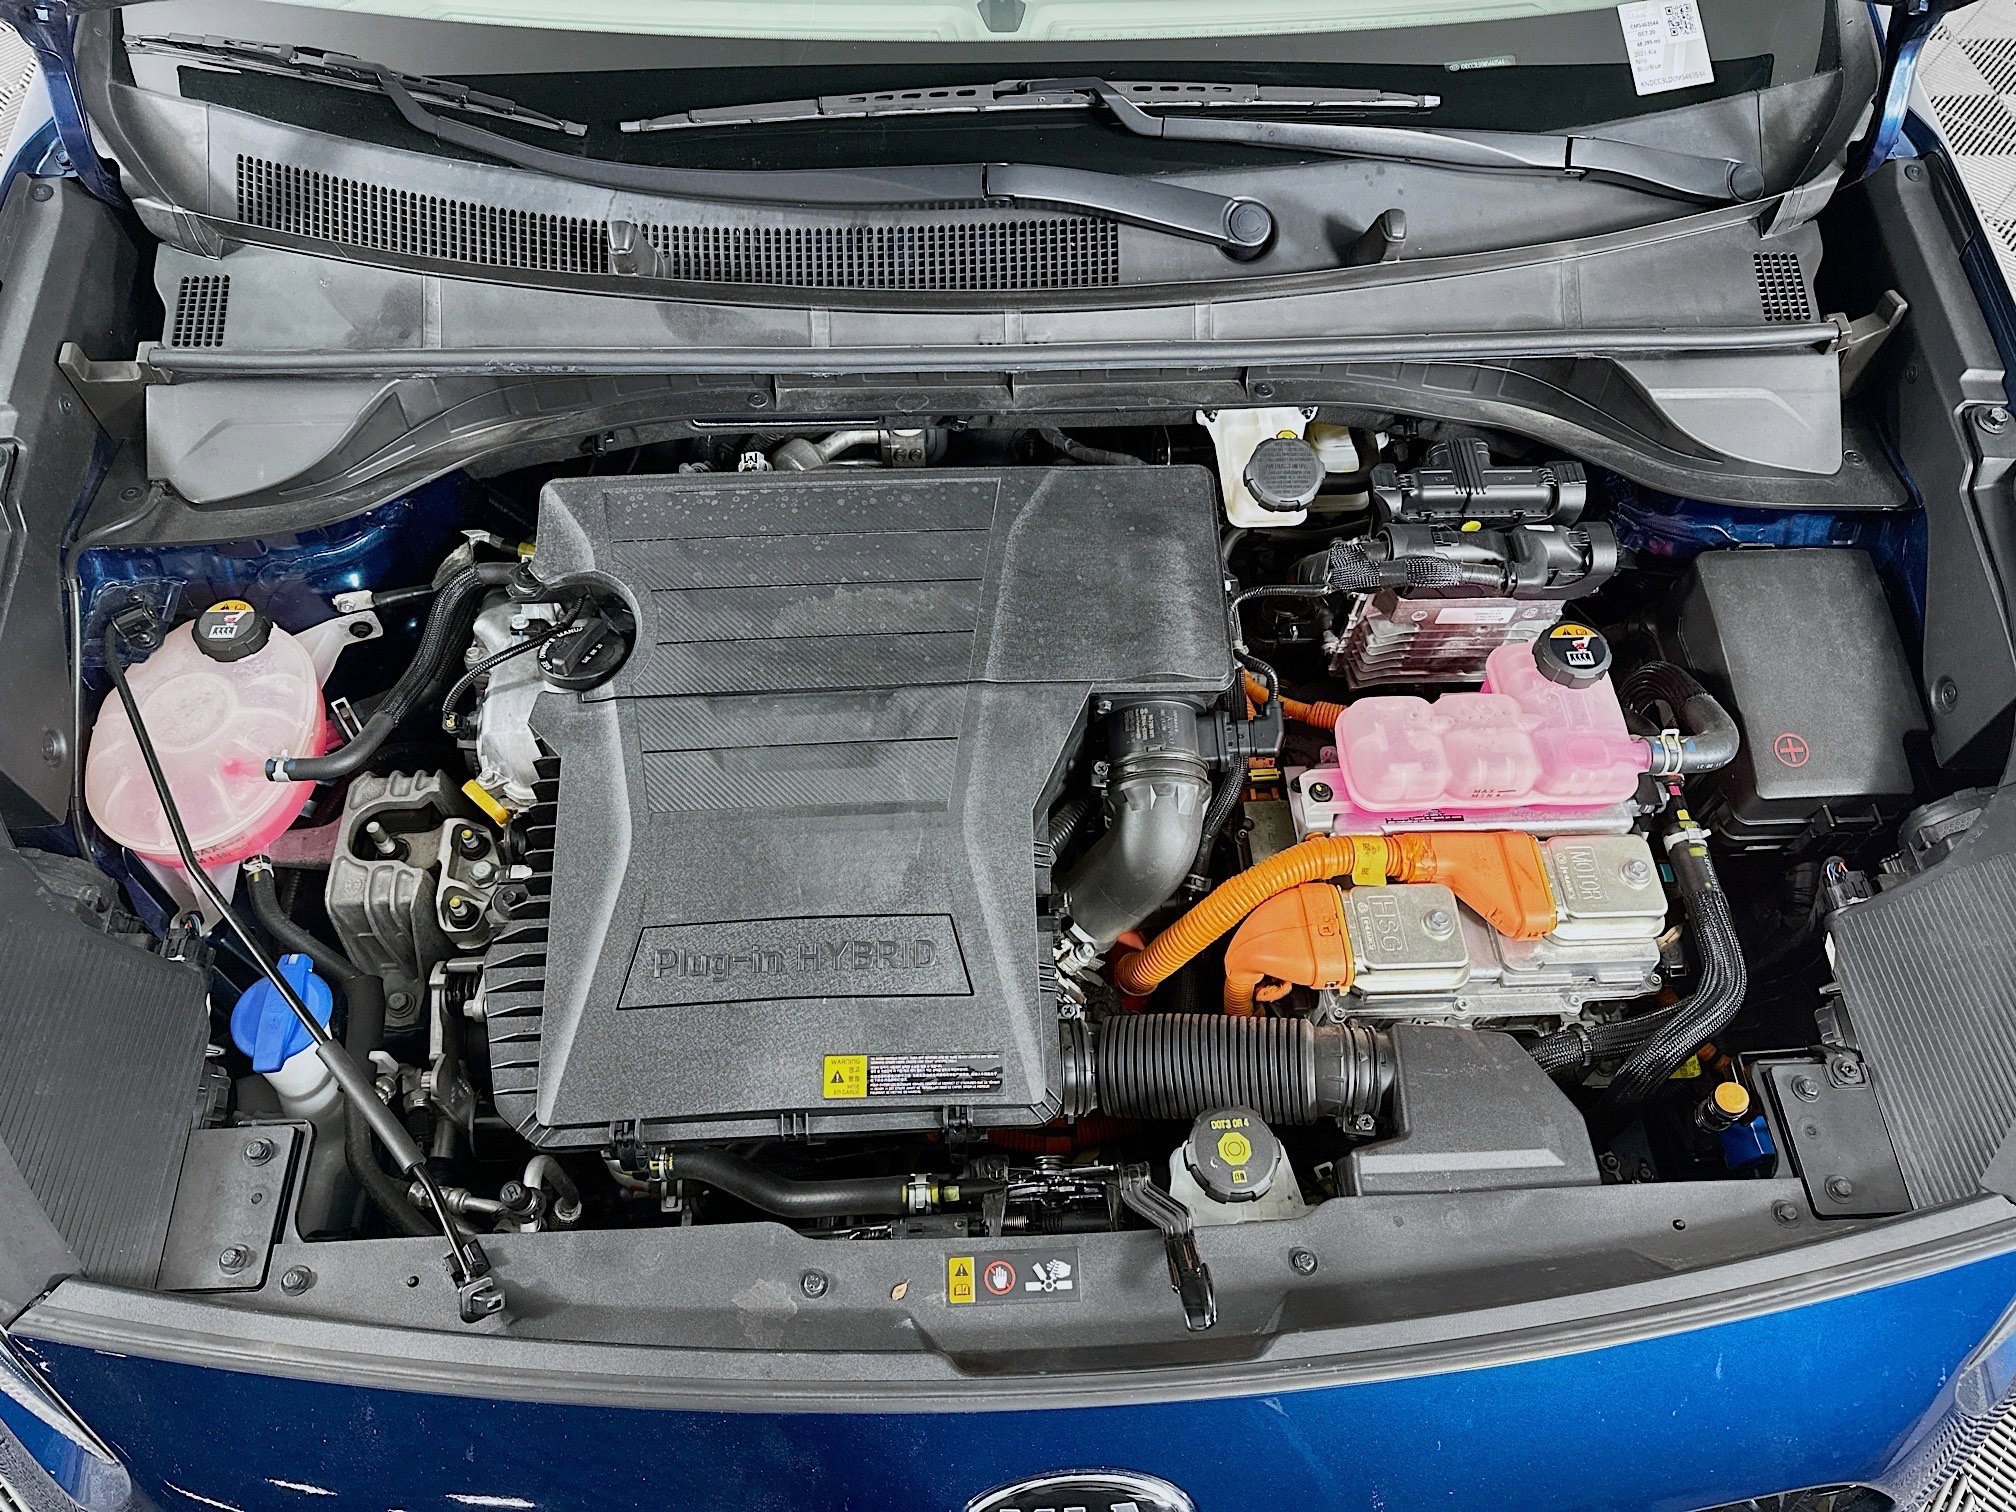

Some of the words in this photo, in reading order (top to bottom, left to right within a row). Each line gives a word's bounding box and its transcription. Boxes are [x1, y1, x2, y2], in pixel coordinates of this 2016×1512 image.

[1569, 850, 1603, 900] MOTOR
[1371, 900, 1404, 952] HSG
[653, 944, 784, 983] Plug-in
[796, 939, 938, 972] HYBRID
[1232, 1118, 1243, 1129] OR
